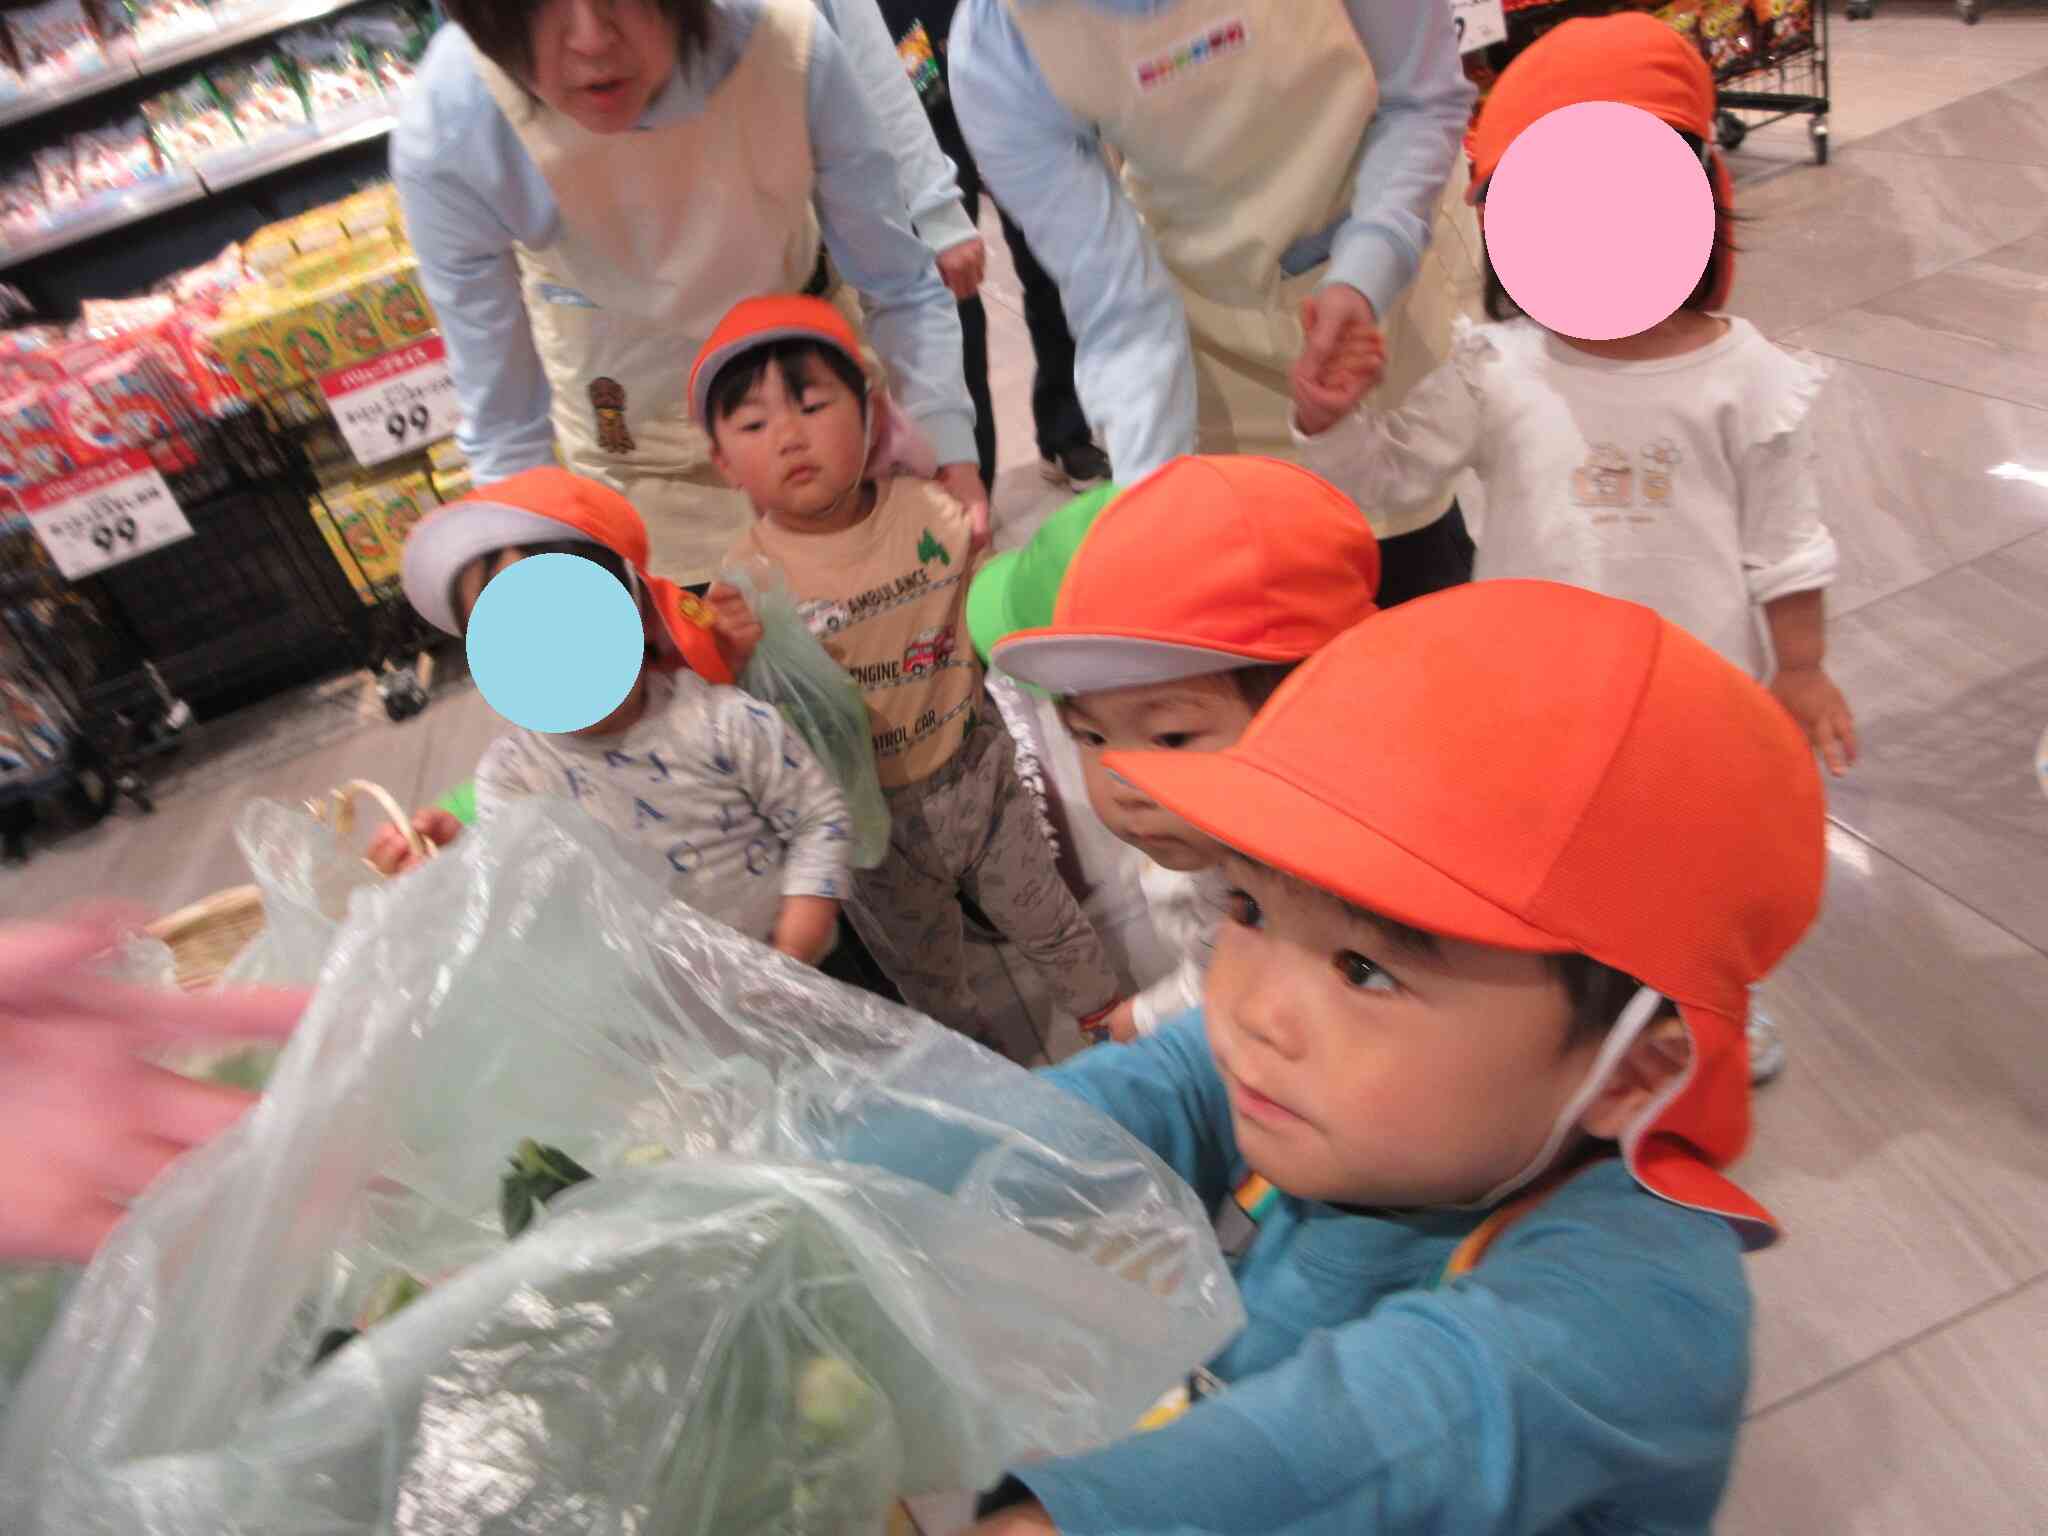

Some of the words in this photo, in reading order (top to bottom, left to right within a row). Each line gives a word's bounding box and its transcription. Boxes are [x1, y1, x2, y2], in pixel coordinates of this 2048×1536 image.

[385, 403, 429, 440] 99
[93, 516, 136, 552] 99
[848, 568, 929, 615] AMBULANCE
[871, 727, 907, 751] ATROL
[914, 710, 936, 735] CAR
